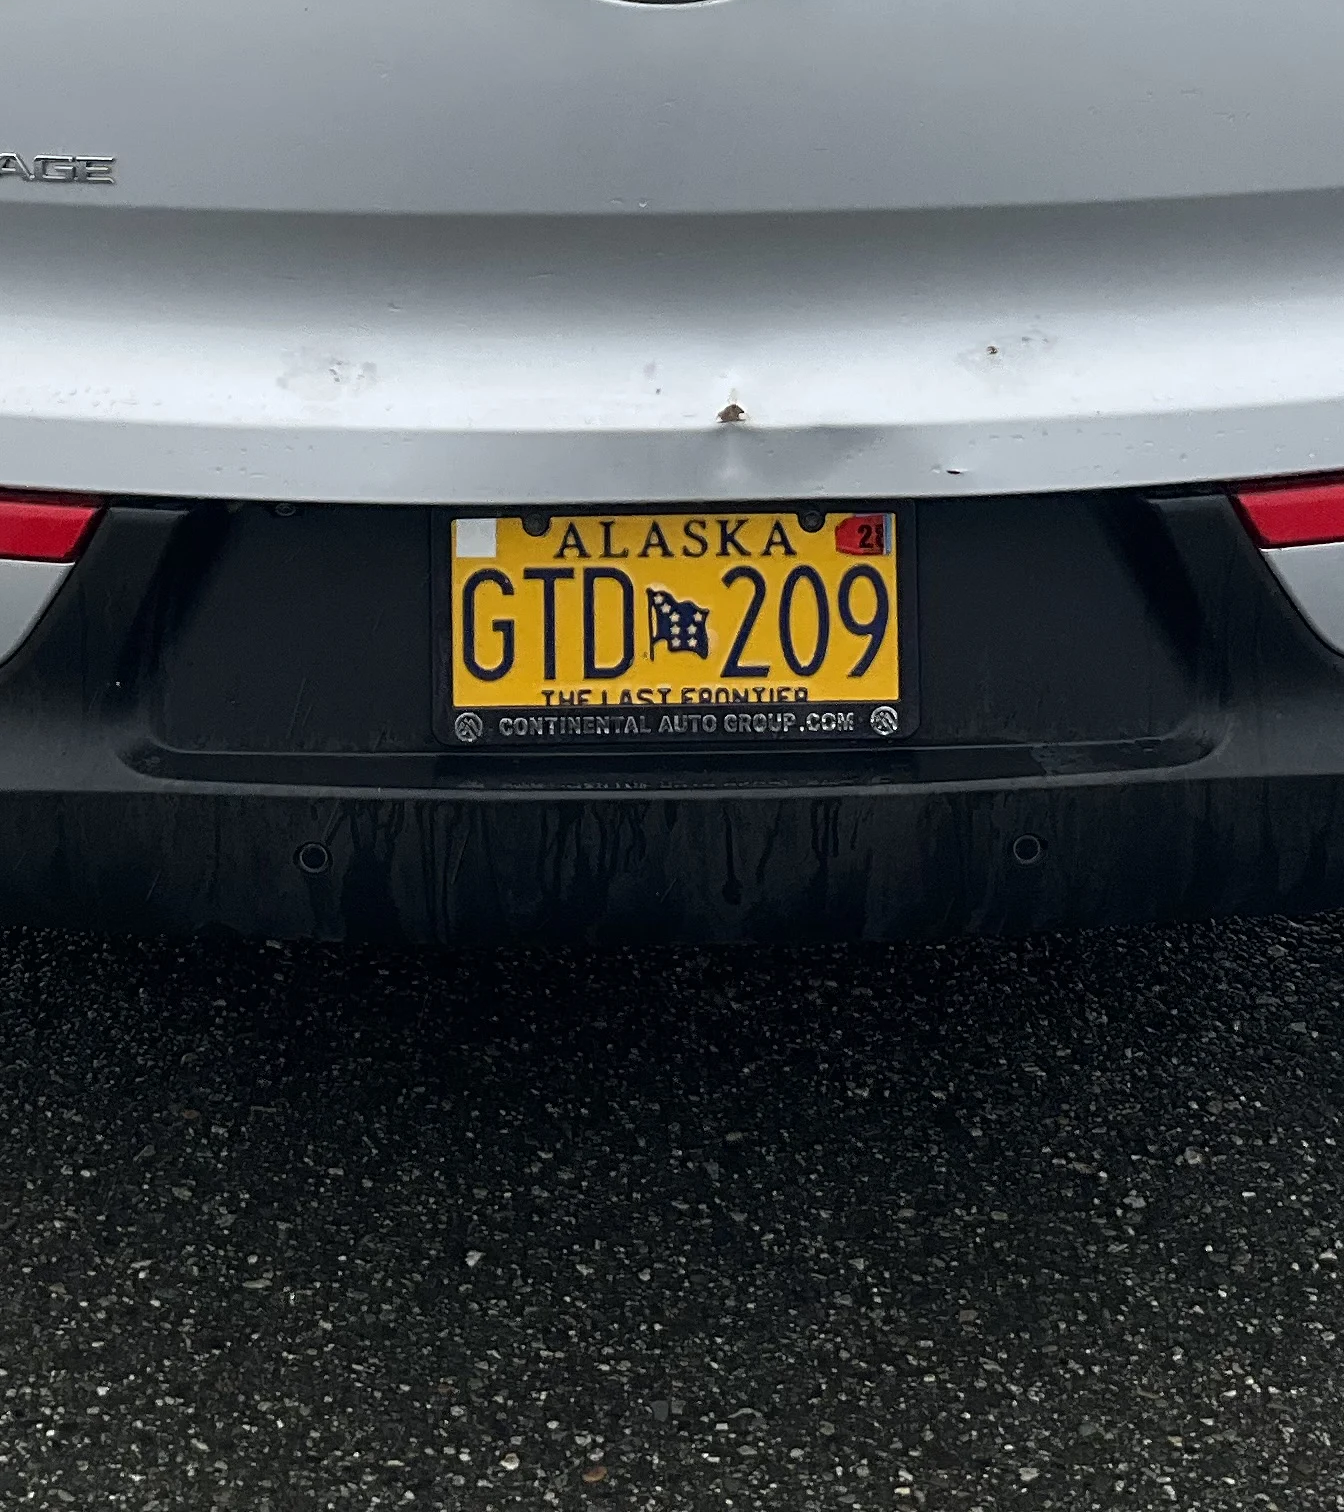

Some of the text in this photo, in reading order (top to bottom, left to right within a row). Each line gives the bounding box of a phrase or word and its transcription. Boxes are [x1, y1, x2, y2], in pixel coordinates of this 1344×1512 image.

[553, 519, 797, 559] ALASKA
[461, 564, 889, 682] GTD 209
[541, 685, 808, 706] THE LAST FRONTIER
[498, 710, 854, 737] CONTINENTAL AUTO GROUP.COM
